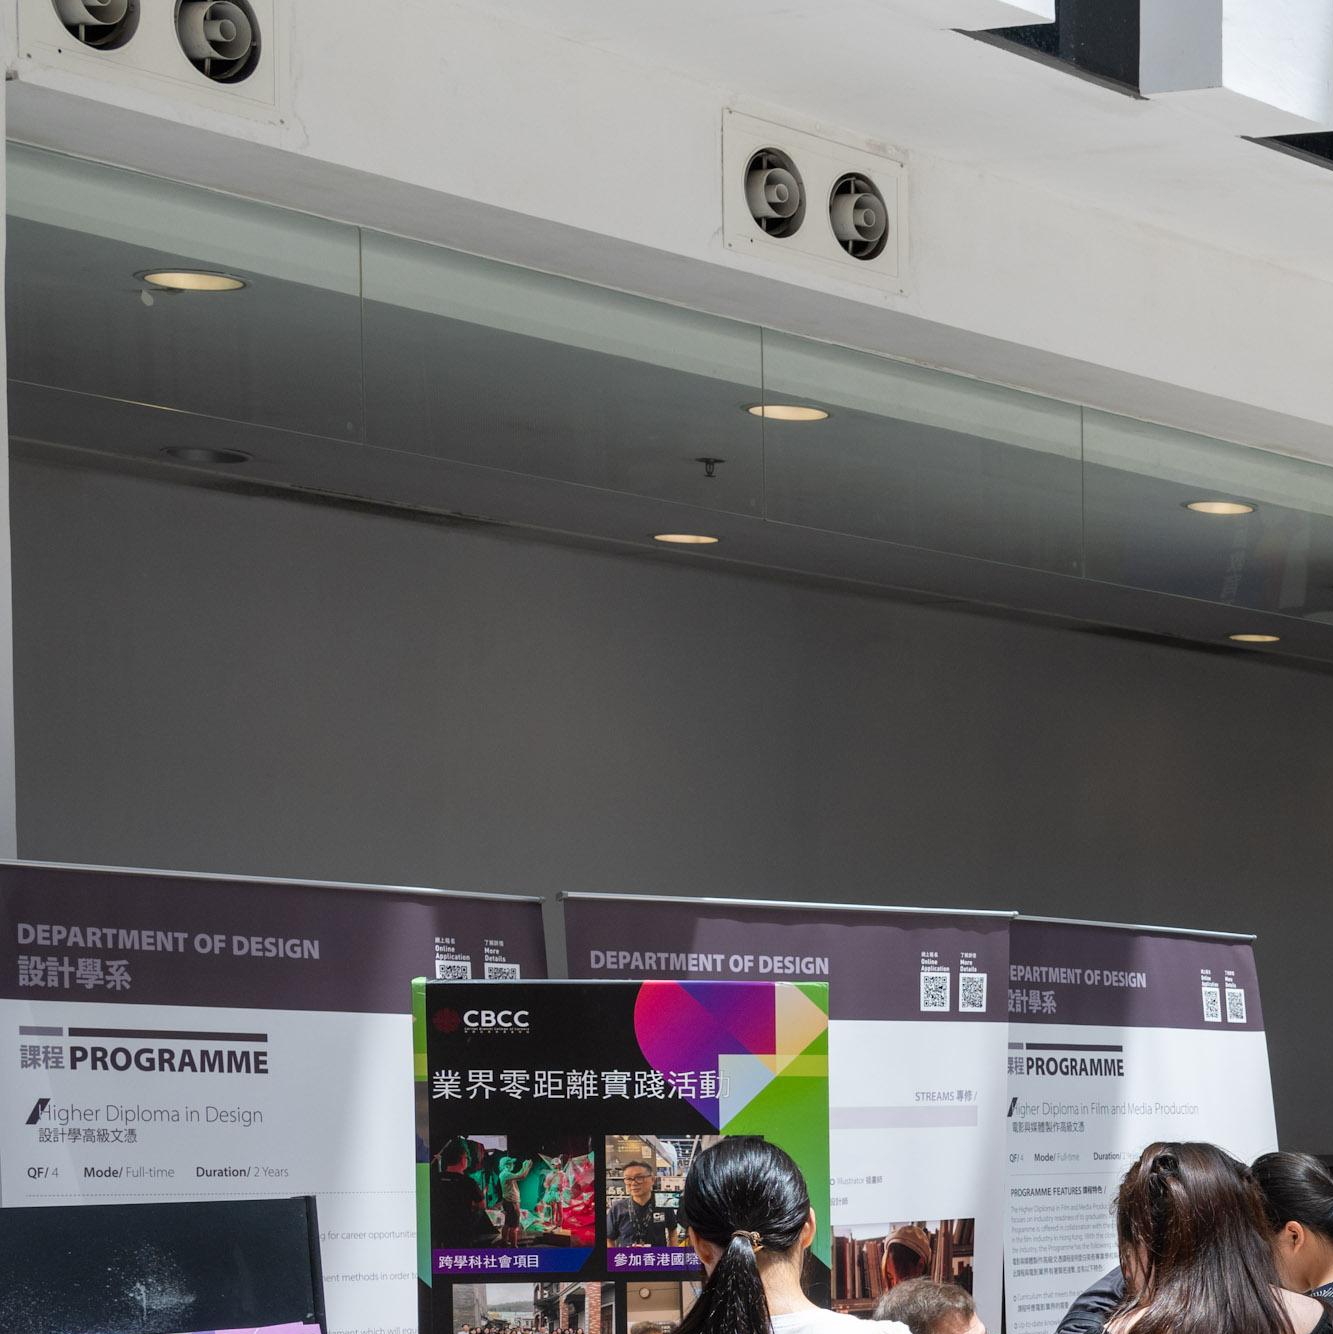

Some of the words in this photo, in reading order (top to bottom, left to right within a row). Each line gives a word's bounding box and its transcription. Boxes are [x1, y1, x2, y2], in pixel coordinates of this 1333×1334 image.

[17, 923, 188, 952] DEPARTMENT
[193, 932, 227, 955] OF
[232, 935, 320, 960] DESIGN
[435, 945, 455, 953] Online
[435, 953, 471, 961] Application
[484, 947, 499, 955] More
[484, 955, 506, 963] Details
[590, 950, 725, 972] DEPARTMENT
[729, 954, 755, 973] OF
[759, 955, 830, 975] DESIGN
[921, 965, 950, 973] Application
[17, 954, 132, 991] 設計學系
[1010, 965, 1082, 985] EPARTMENT
[1084, 969, 1101, 985] OF
[1103, 970, 1147, 988] DESIGN
[463, 1010, 530, 1027] CBCC
[20, 1044, 65, 1070] 課程
[69, 1046, 269, 1075] PROGRAMME
[1026, 1057, 1124, 1077] PROGRAMME
[432, 1069, 732, 1100] 業界零距離實踐活動
[915, 1091, 955, 1102] STREAMS
[38, 1102, 101, 1126] Higher
[106, 1104, 180, 1126] Diploma
[185, 1105, 200, 1122] in
[205, 1105, 264, 1127] Design
[1042, 1102, 1079, 1118] Diploma
[1080, 1103, 1089, 1115] in
[1091, 1102, 1109, 1115] Film
[1111, 1103, 1126, 1115] and
[1128, 1103, 1153, 1115] Media
[1154, 1103, 1200, 1116] Production
[38, 1127, 138, 1144] 設計學高級文憑
[27, 1166, 49, 1180] QF/
[51, 1166, 59, 1178] 4
[83, 1165, 123, 1179] Mode/
[125, 1165, 175, 1178] Full-time
[196, 1165, 251, 1179] Duration/
[254, 1166, 261, 1177] 2
[262, 1166, 289, 1178] Years
[438, 1254, 540, 1270] 跨學科社會項目
